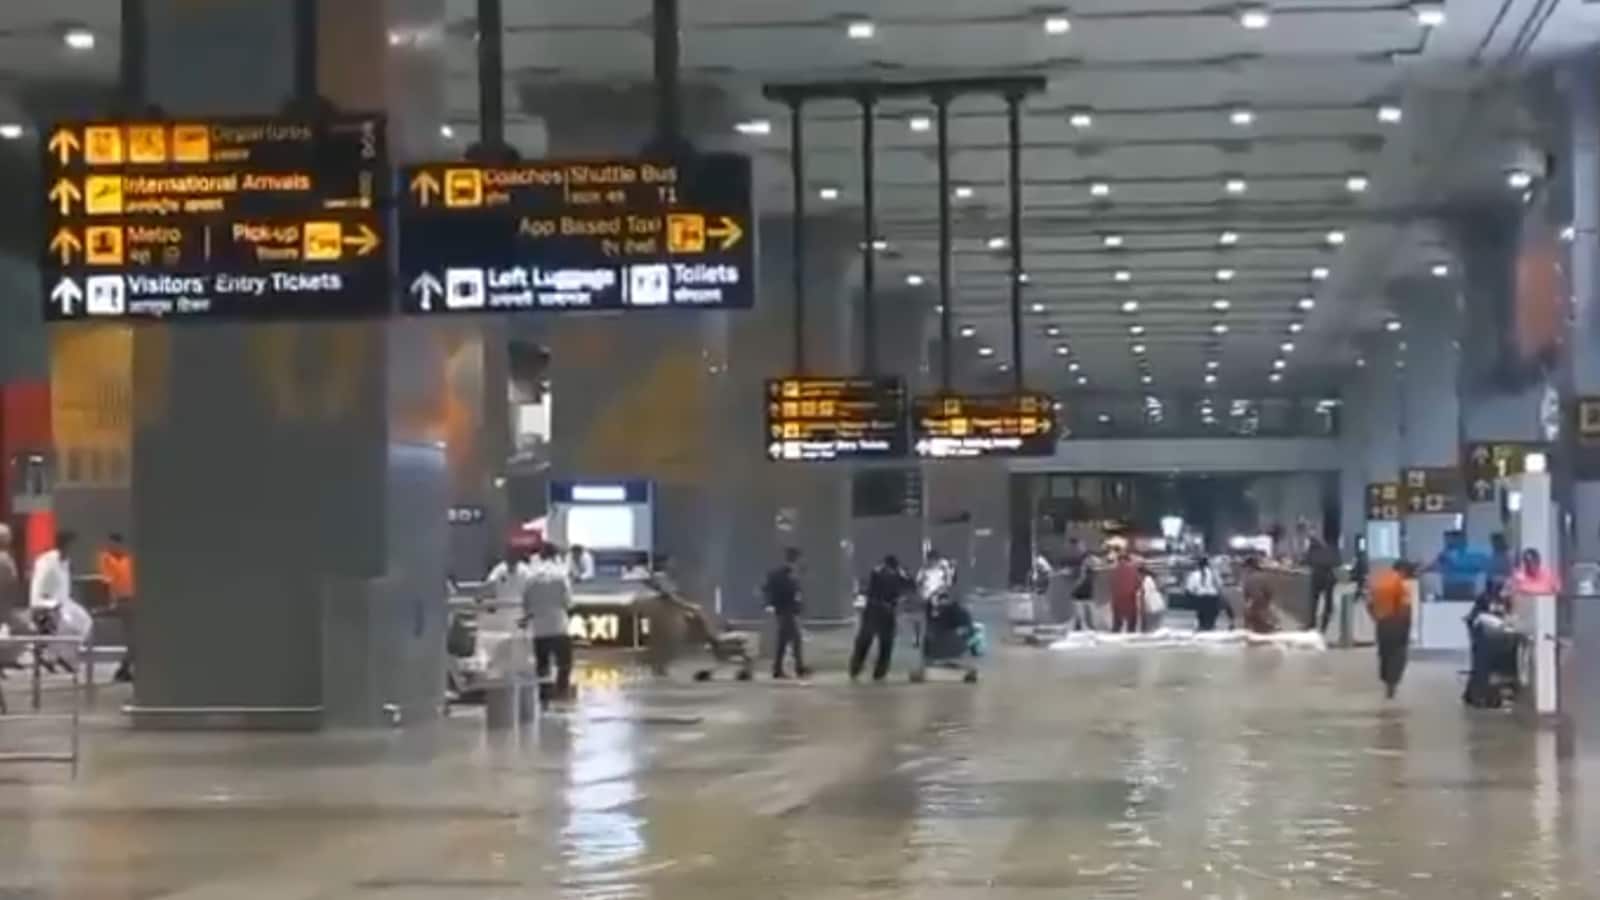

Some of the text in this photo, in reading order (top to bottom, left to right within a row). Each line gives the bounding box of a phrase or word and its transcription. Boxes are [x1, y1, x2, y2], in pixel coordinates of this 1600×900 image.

[213, 122, 312, 143] Departures
[125, 173, 311, 194] International Arrivals
[484, 169, 564, 186] Coaches
[569, 165, 677, 183] Shuttle Bus
[128, 226, 182, 243] Metro
[233, 222, 300, 244] Pick-up
[520, 216, 662, 235] App Based Taxi
[214, 274, 266, 295] Entry
[271, 271, 342, 291] Tickets
[488, 267, 528, 287] Left
[674, 263, 739, 283] Toilets
[567, 613, 620, 639] AXI
